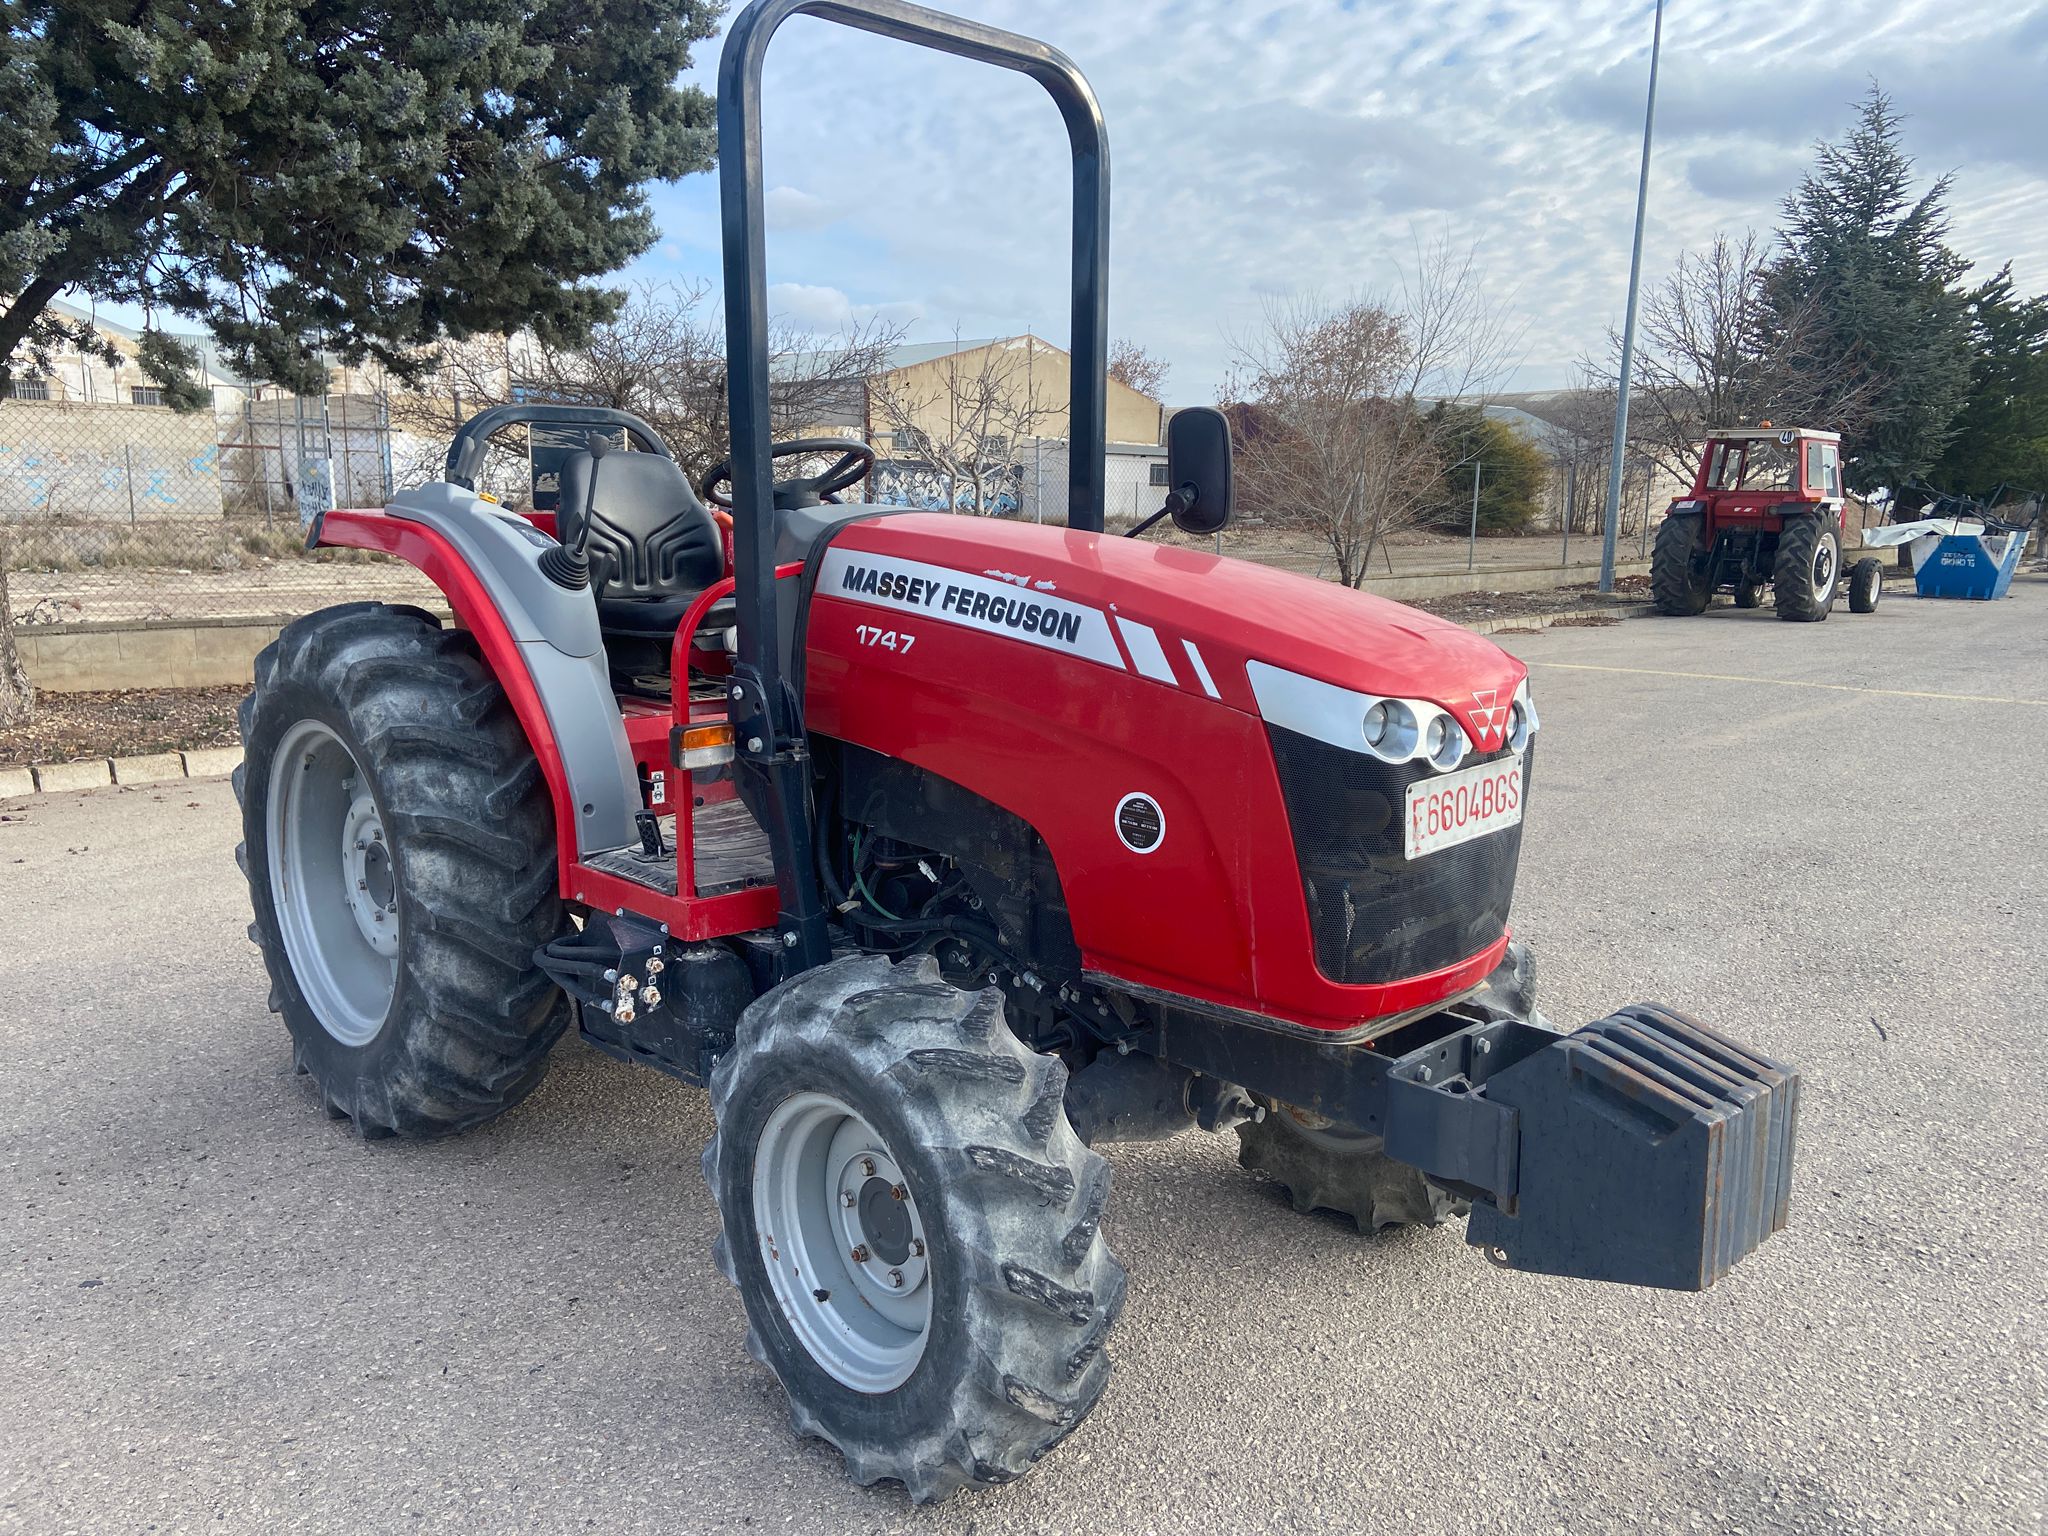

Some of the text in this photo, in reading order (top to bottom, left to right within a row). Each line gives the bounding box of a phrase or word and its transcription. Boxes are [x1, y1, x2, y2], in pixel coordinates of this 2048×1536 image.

[1781, 430, 1793, 443] 40
[842, 565, 1082, 644] MASSEY FERGUSON
[855, 624, 915, 655] 1747
